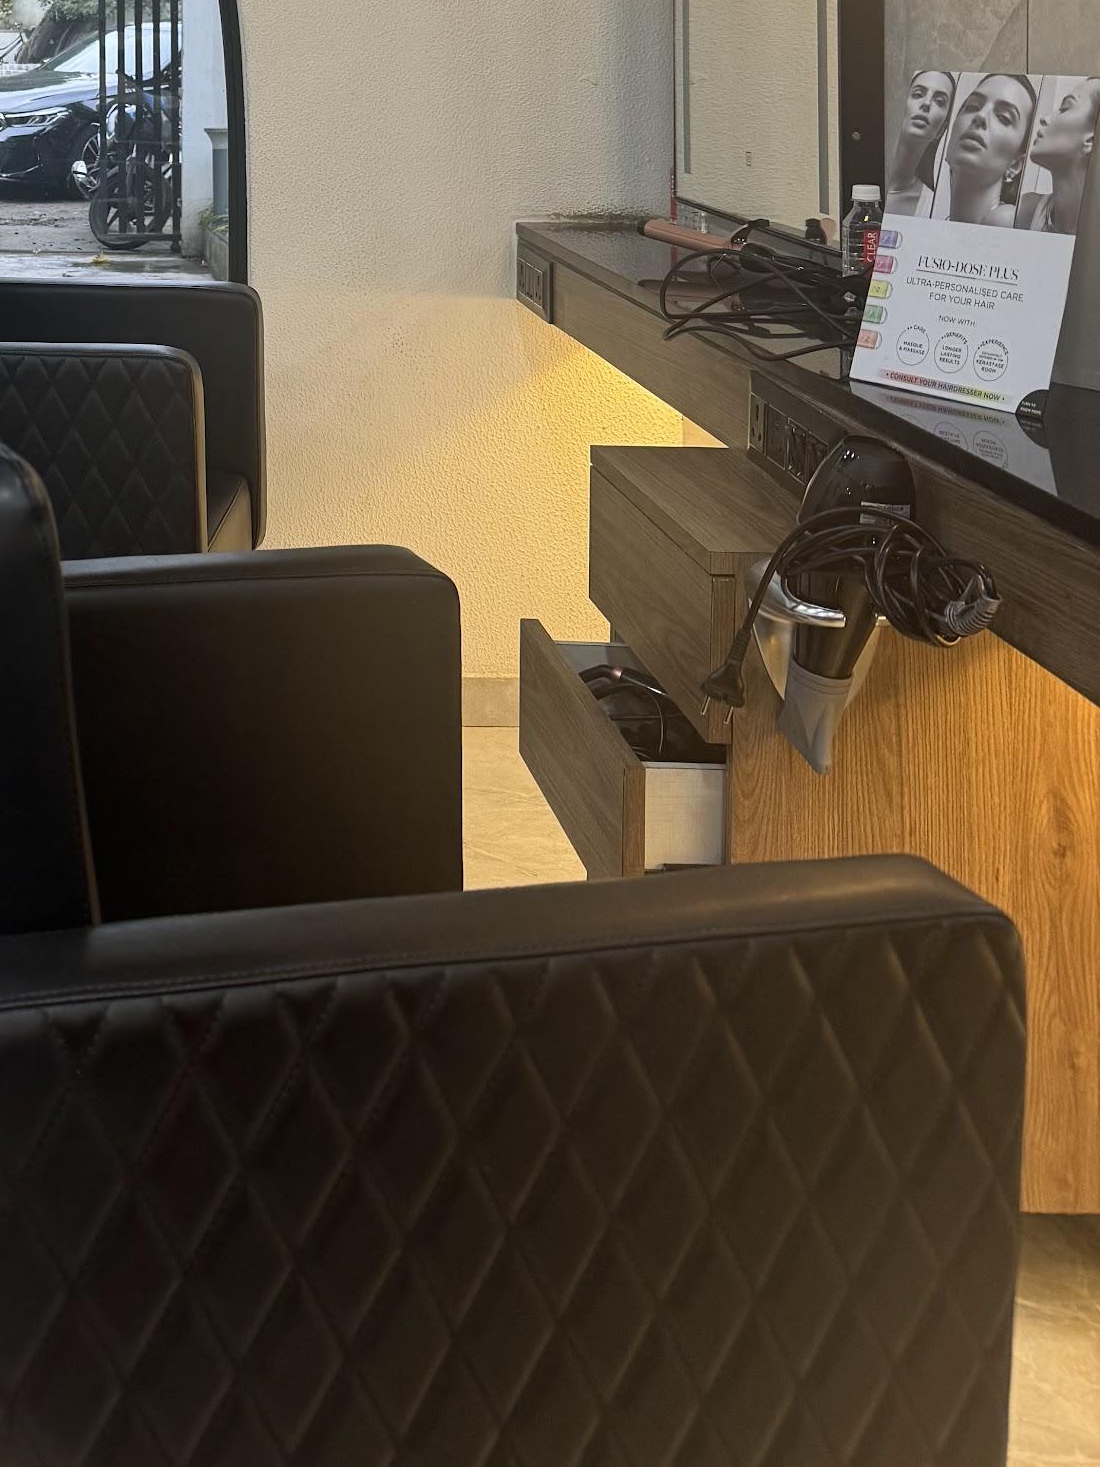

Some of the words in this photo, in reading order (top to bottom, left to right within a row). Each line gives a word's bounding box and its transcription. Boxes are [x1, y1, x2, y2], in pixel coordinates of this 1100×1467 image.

[866, 232, 877, 263] CLEAR
[918, 255, 988, 277] FUSIO-DOSE
[989, 265, 1019, 281] PLUS
[906, 276, 998, 298] ULTRA-PERSONALISED
[1000, 291, 1024, 302] CARE
[929, 292, 947, 302] FOR
[949, 295, 972, 307] YOUR
[973, 299, 996, 310] HAIR
[939, 315, 956, 323] NOW
[890, 372, 919, 384] CONSULT
[920, 379, 937, 389] YOUR
[937, 382, 983, 398] HAIRDRESSER
[983, 392, 1001, 401] NOW
